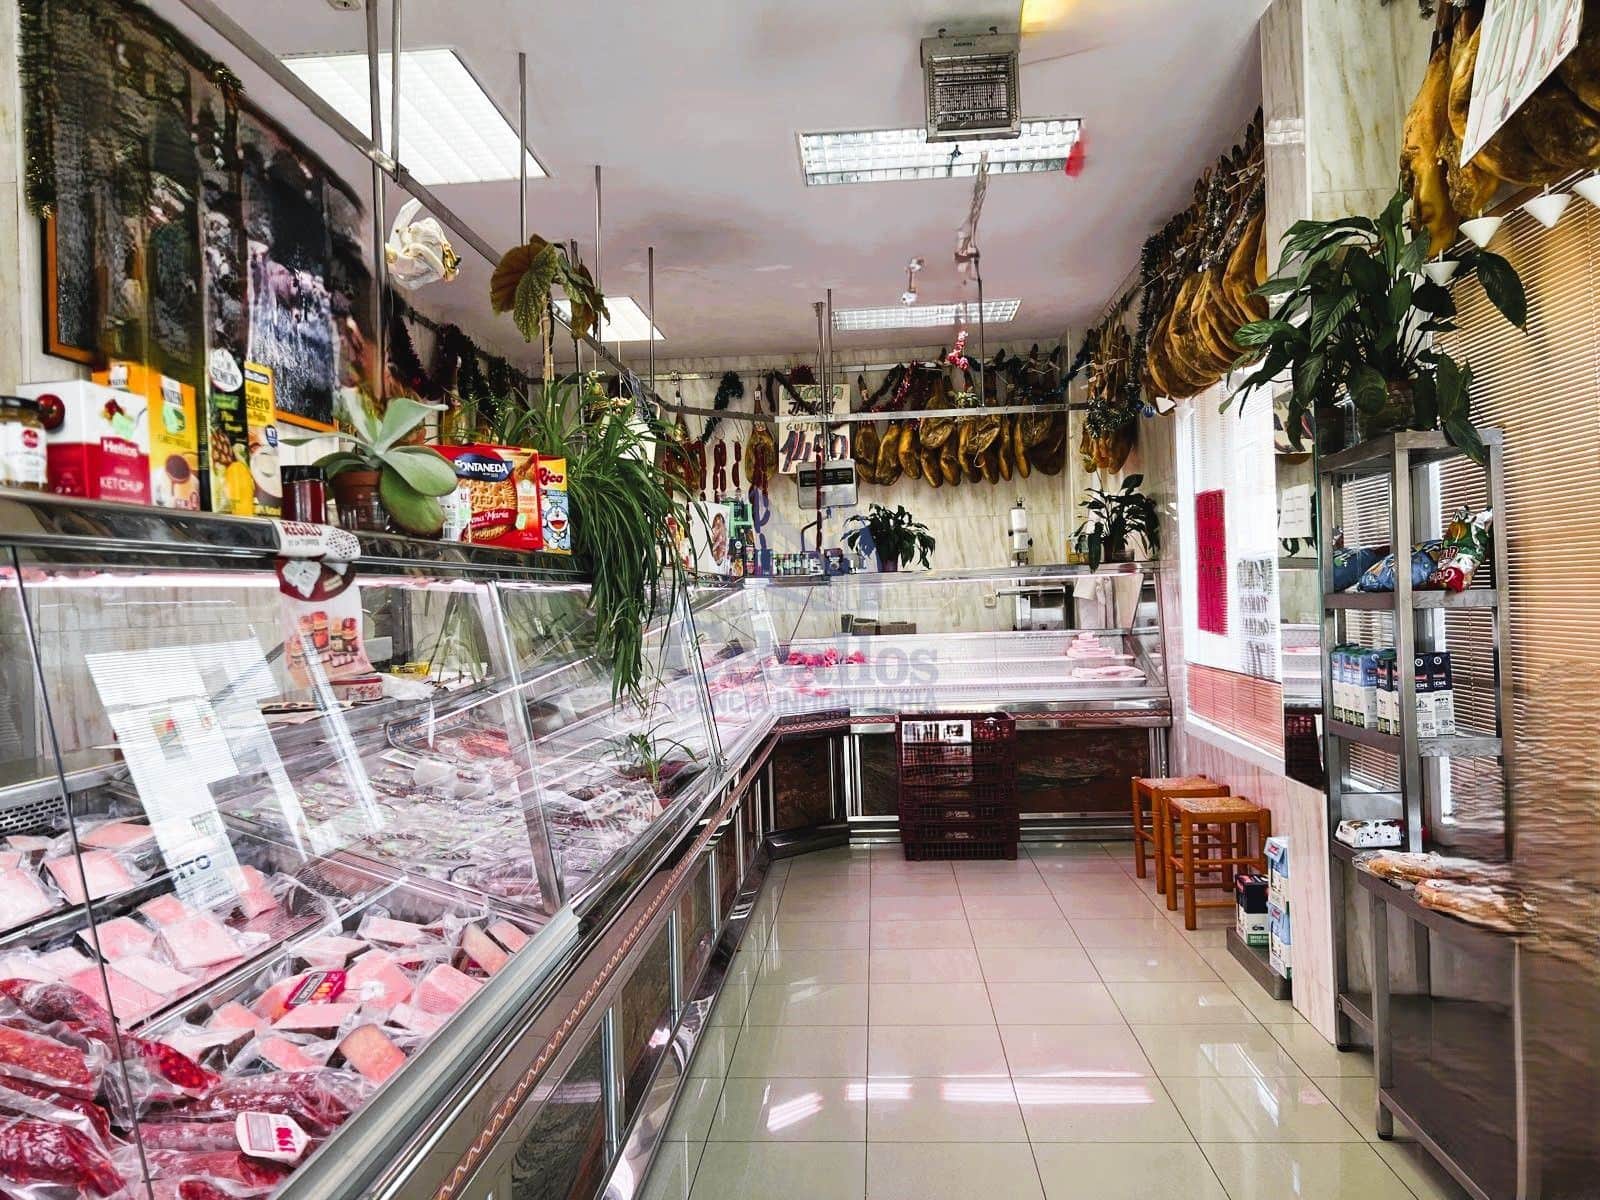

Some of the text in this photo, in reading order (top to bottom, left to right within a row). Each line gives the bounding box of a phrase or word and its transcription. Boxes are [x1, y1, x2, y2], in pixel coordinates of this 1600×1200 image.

[102, 439, 139, 459] Helios
[454, 459, 509, 475] FONTANEDA
[99, 476, 145, 492] KETCHUP
